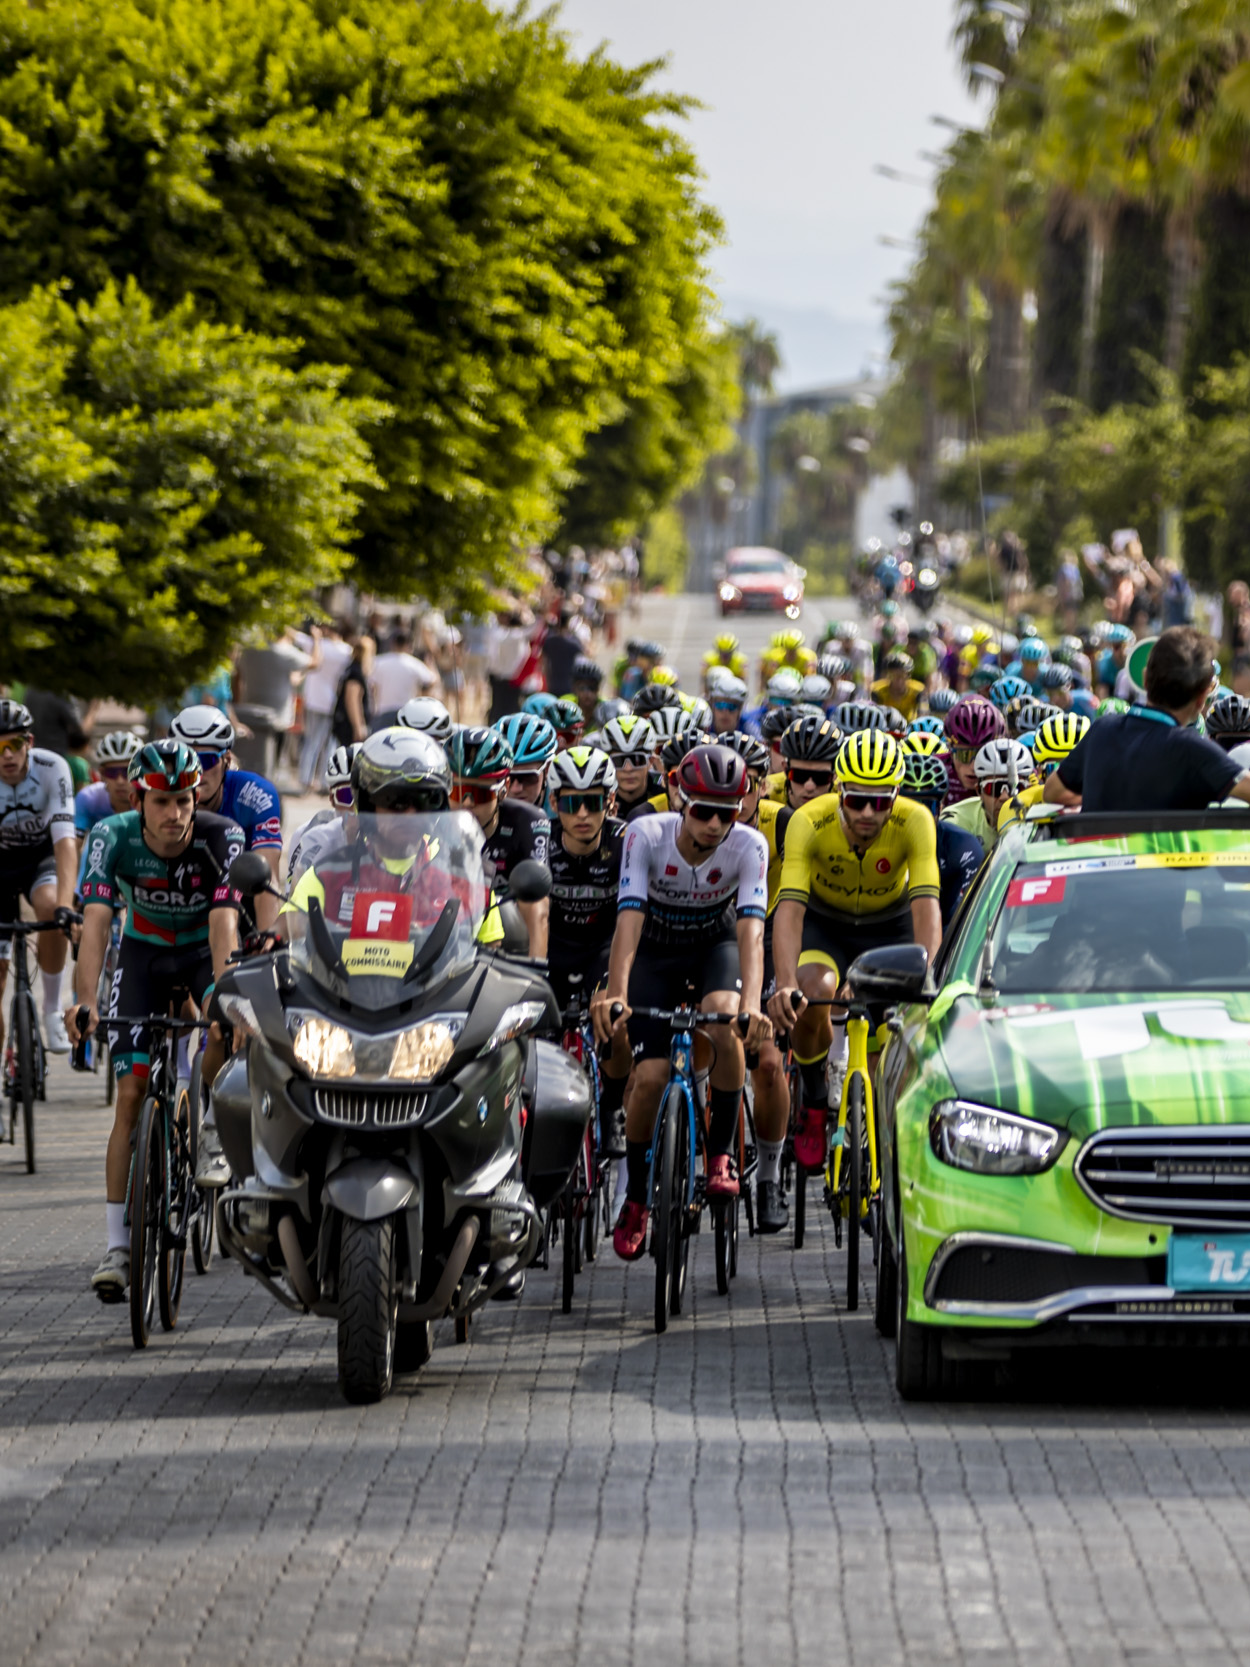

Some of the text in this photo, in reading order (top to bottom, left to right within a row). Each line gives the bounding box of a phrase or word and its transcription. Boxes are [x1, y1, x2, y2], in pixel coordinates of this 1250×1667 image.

[816, 872, 898, 897] Beykoz
[1021, 880, 1052, 901] F
[134, 886, 207, 906] BORA
[366, 901, 397, 932] F
[364, 946, 390, 957] MOTO
[345, 958, 408, 971] COMMISSAIRE
